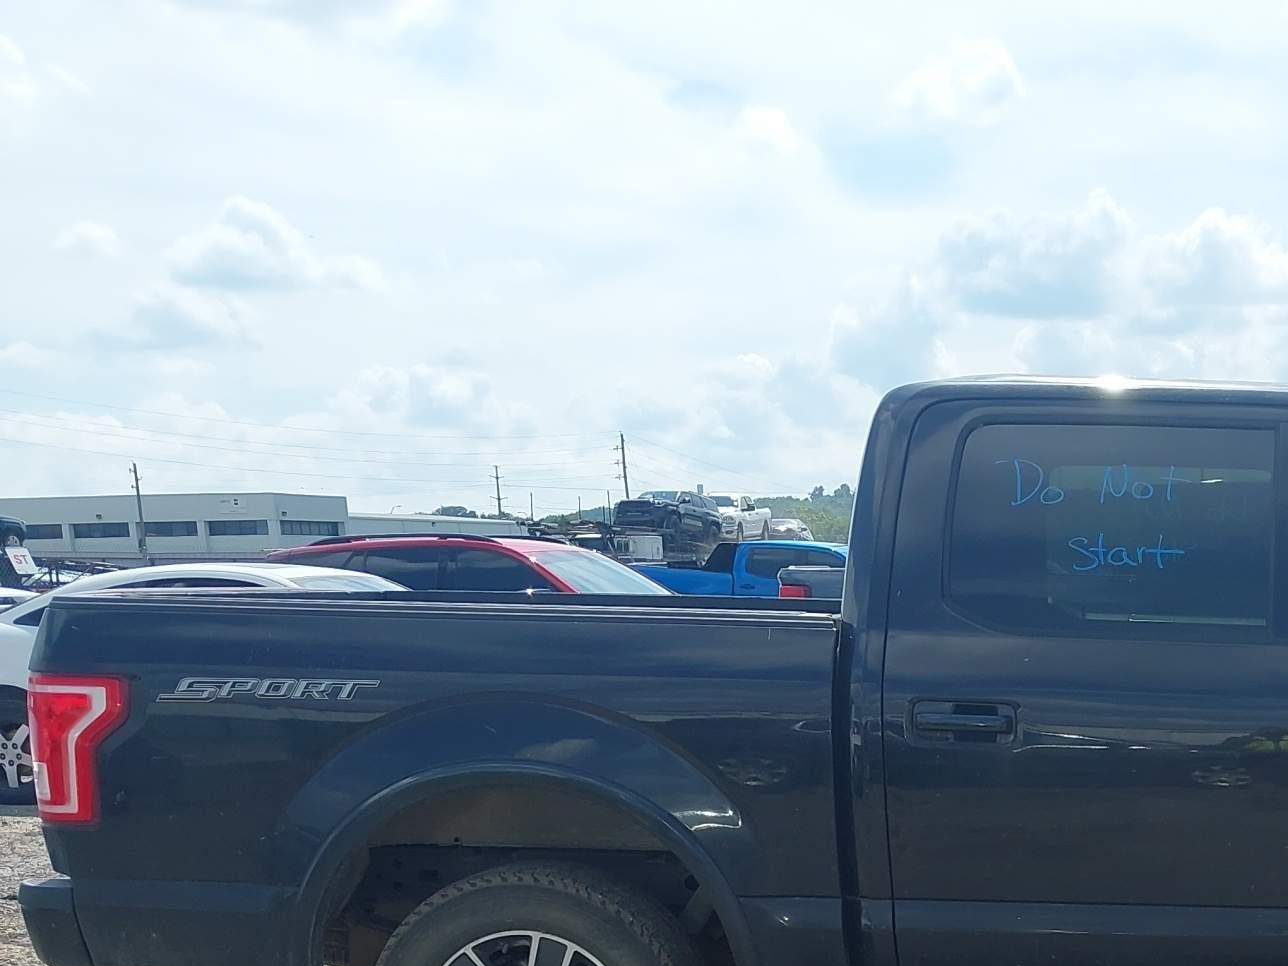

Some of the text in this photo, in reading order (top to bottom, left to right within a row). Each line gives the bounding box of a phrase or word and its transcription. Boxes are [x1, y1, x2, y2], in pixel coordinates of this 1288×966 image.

[996, 456, 1192, 506] Do Not
[1068, 533, 1185, 571] Start
[156, 677, 381, 702] SPORT
